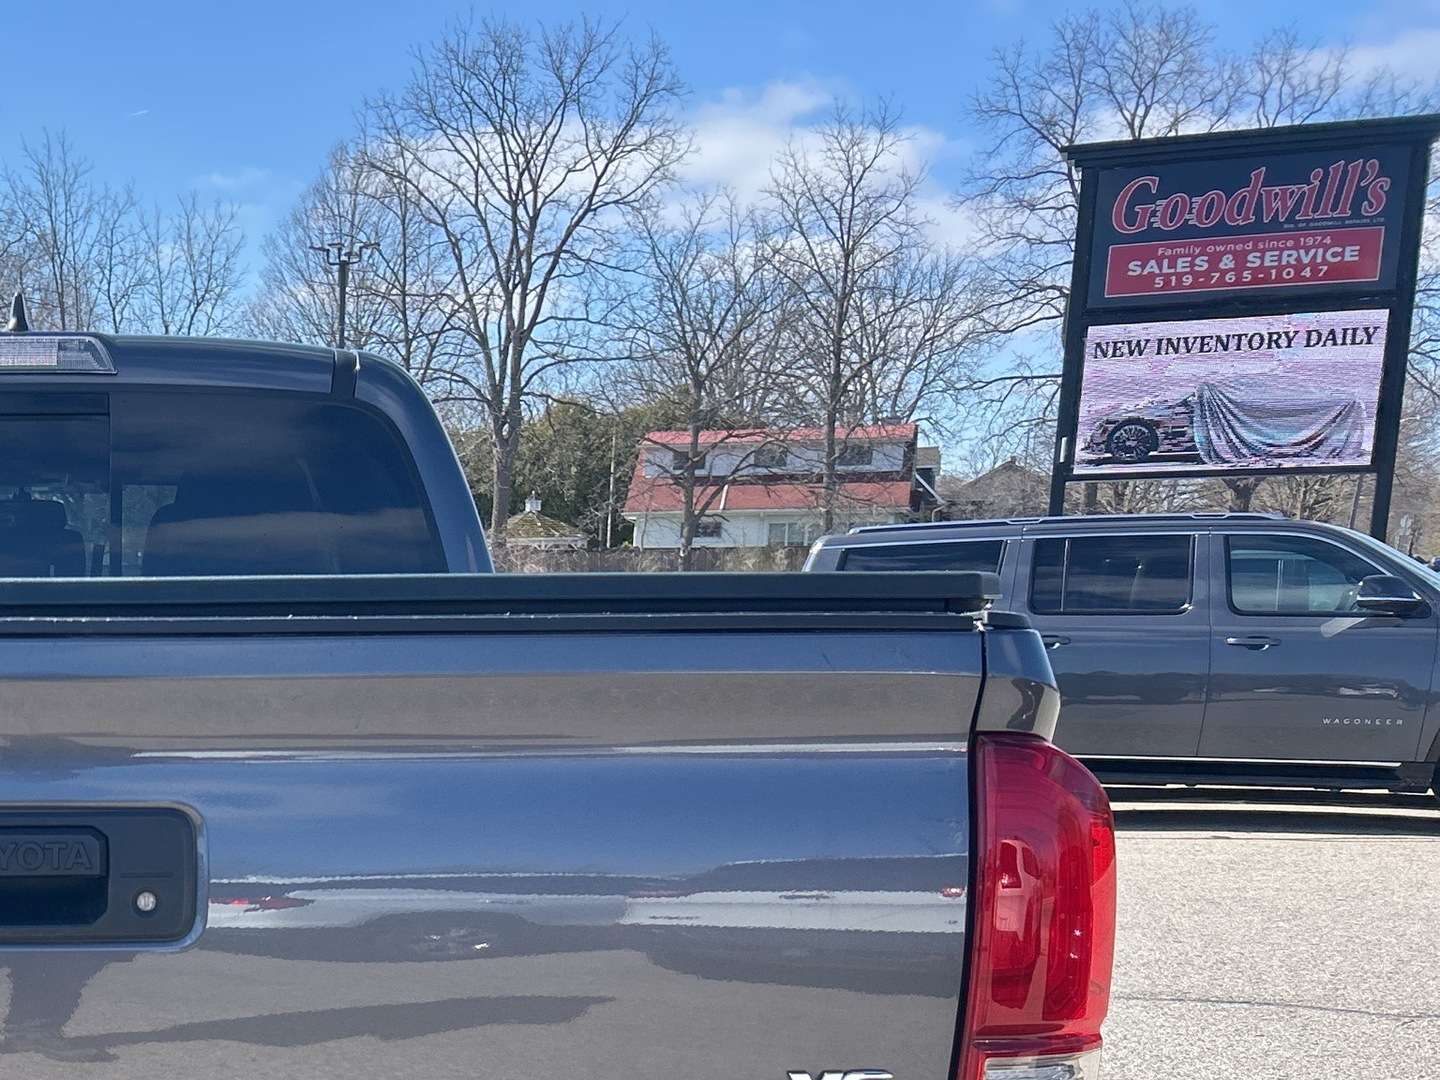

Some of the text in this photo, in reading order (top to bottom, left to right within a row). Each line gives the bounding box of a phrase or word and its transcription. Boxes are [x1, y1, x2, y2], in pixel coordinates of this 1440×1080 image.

[1112, 159, 1391, 234] Goodwill's
[1127, 245, 1361, 276] SALES & SERVICE
[1157, 235, 1332, 257] Family owned since 1974
[1153, 265, 1329, 289] 519-765-1047
[1093, 326, 1380, 359] NEW INVENTORY DAILY
